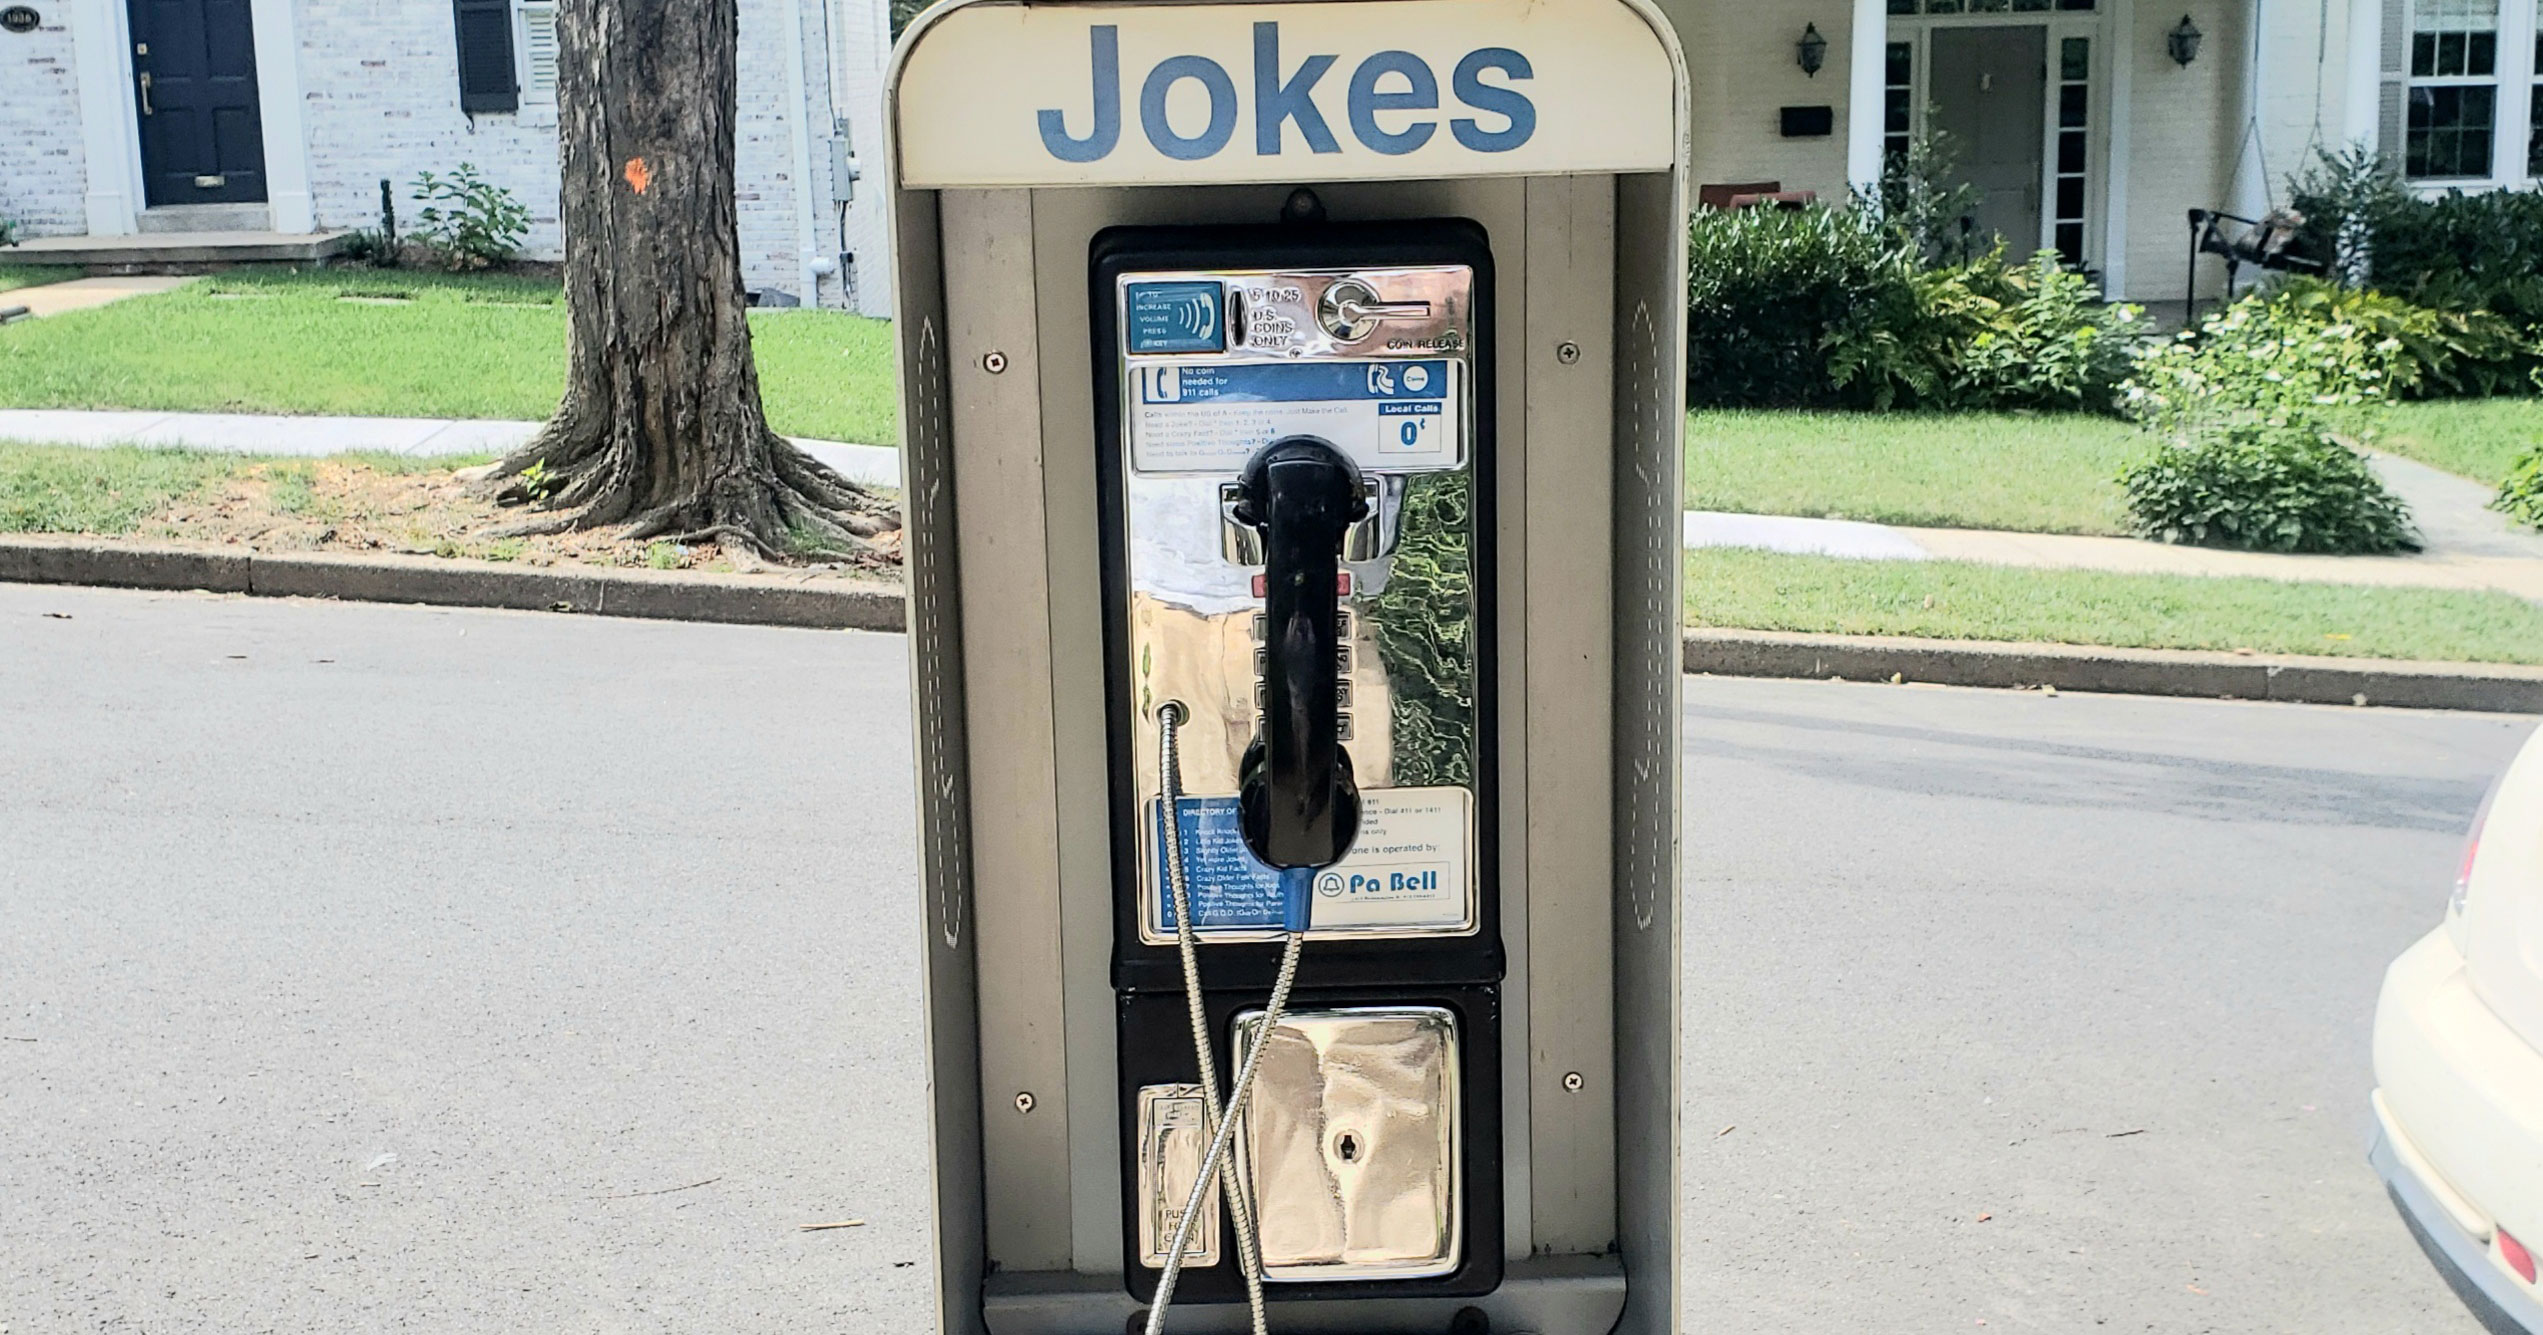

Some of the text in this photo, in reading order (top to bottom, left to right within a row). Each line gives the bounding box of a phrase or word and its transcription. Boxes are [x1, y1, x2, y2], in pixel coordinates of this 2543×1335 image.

[1037, 21, 1537, 164] Jokes
[1136, 303, 1171, 311] INCREASE
[1139, 315, 1169, 323] VOLUME
[1254, 321, 1293, 333] COINS
[1254, 335, 1288, 346] ONLY
[1387, 338, 1465, 351] COIN RELEASE
[1182, 367, 1215, 375] No coin
[1182, 377, 1228, 386] needed for
[1182, 388, 1219, 397] 911 calls
[1385, 404, 1439, 413] Local Calls
[1183, 807, 1237, 817] DIRECTORY OF
[1372, 846, 1380, 854] is
[1383, 844, 1424, 855] operated
[1196, 865, 1214, 874] Crazy
[1196, 874, 1216, 883] Crazy
[1217, 873, 1236, 881] Older
[1350, 870, 1437, 894] Pa Bell
